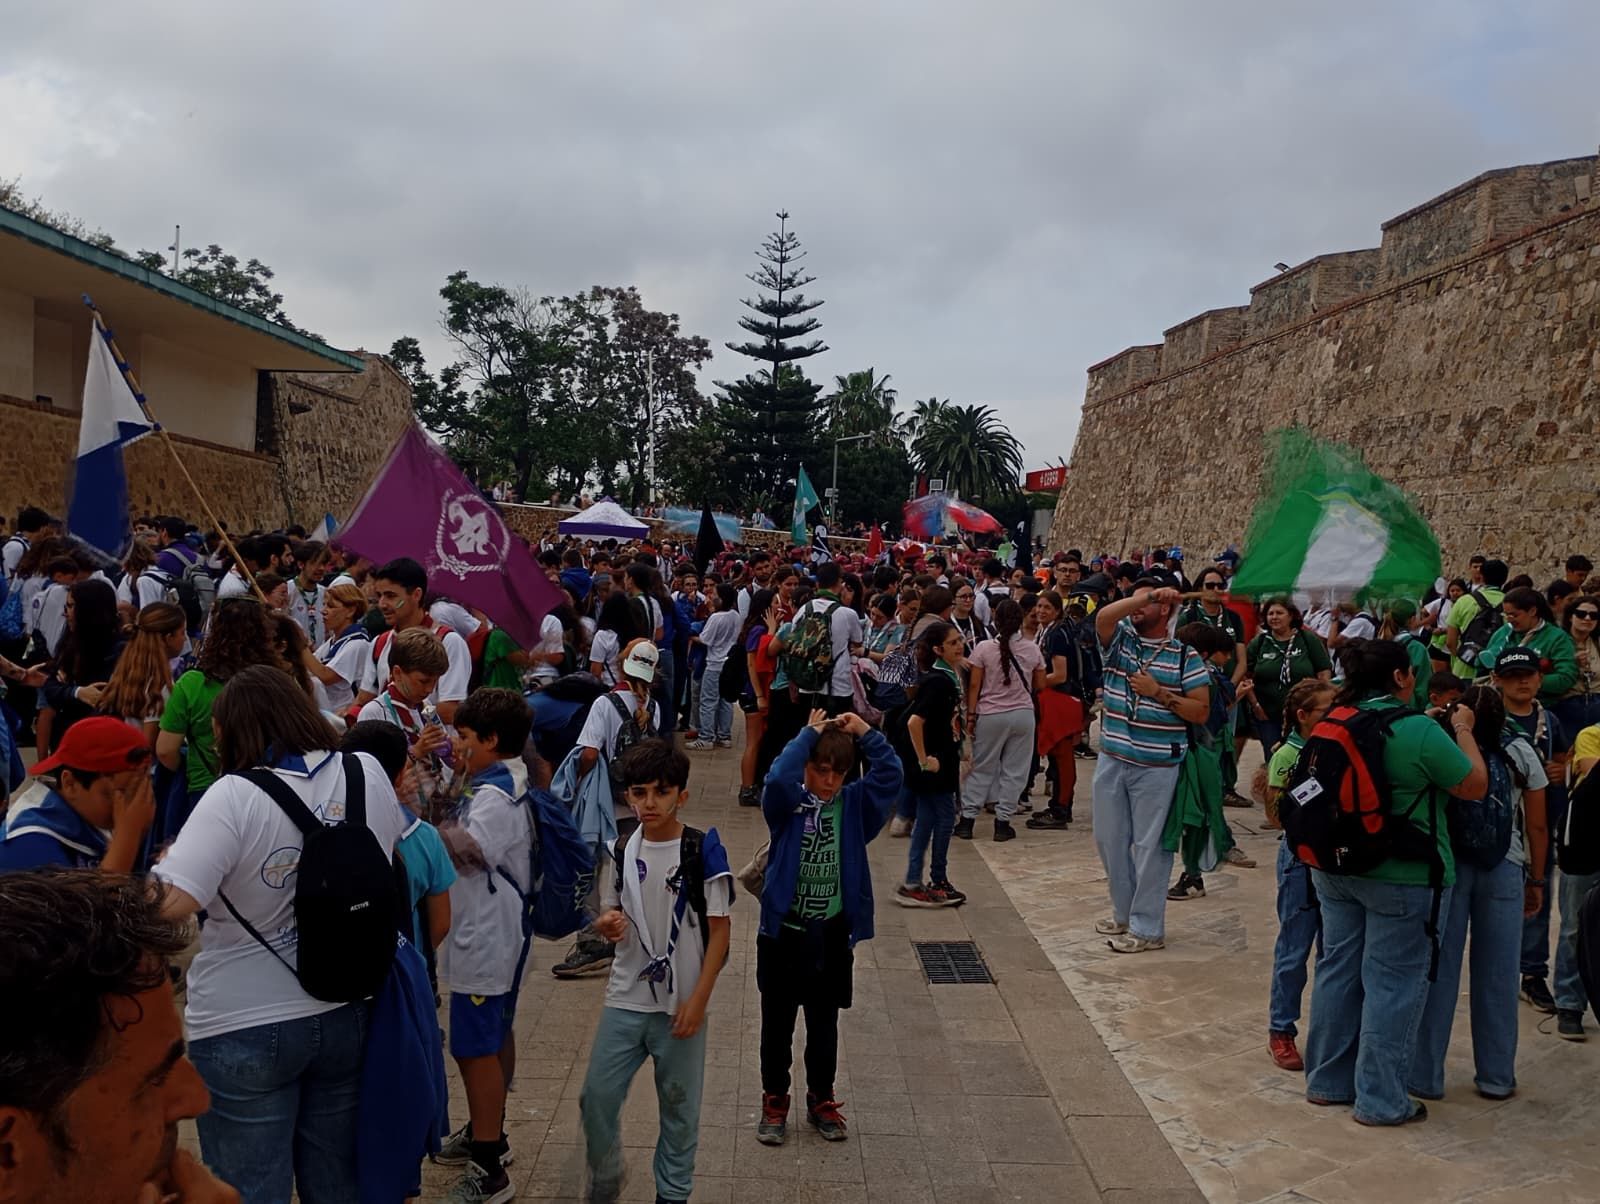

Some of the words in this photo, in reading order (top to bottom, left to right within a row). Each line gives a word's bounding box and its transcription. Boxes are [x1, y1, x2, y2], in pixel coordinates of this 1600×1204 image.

[1500, 653, 1530, 665] adidas
[810, 850, 834, 862] FREE
[810, 883, 835, 897] VIBES
